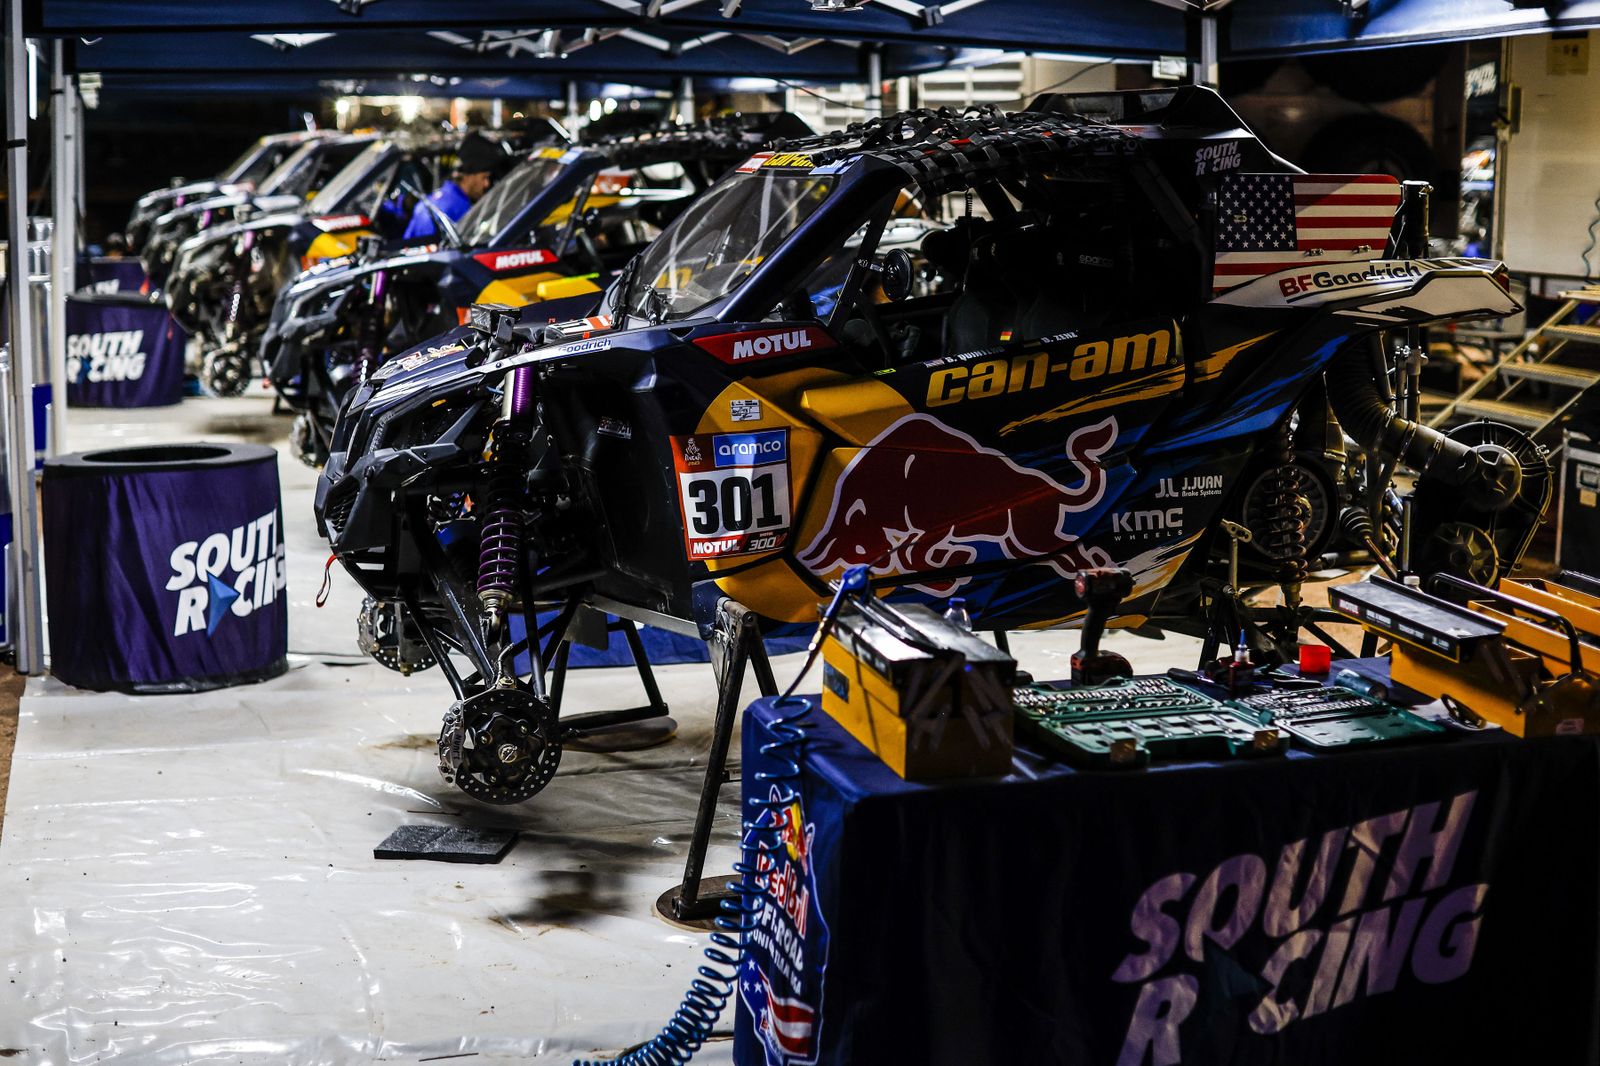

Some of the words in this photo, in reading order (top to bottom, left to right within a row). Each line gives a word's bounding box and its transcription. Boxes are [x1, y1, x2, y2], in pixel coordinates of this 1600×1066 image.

[1195, 141, 1238, 163] SOUTH
[495, 250, 545, 269] MOTUL
[1279, 261, 1421, 297] BFGoodrich
[66, 329, 144, 358] SOUTH
[733, 330, 811, 359] MOTUL
[925, 329, 1171, 408] can-am
[719, 440, 781, 456] aramco
[688, 473, 783, 534] 301
[1181, 489, 1199, 497] Brake
[693, 539, 740, 554] MOTUL
[1111, 789, 1480, 984] SOUTH
